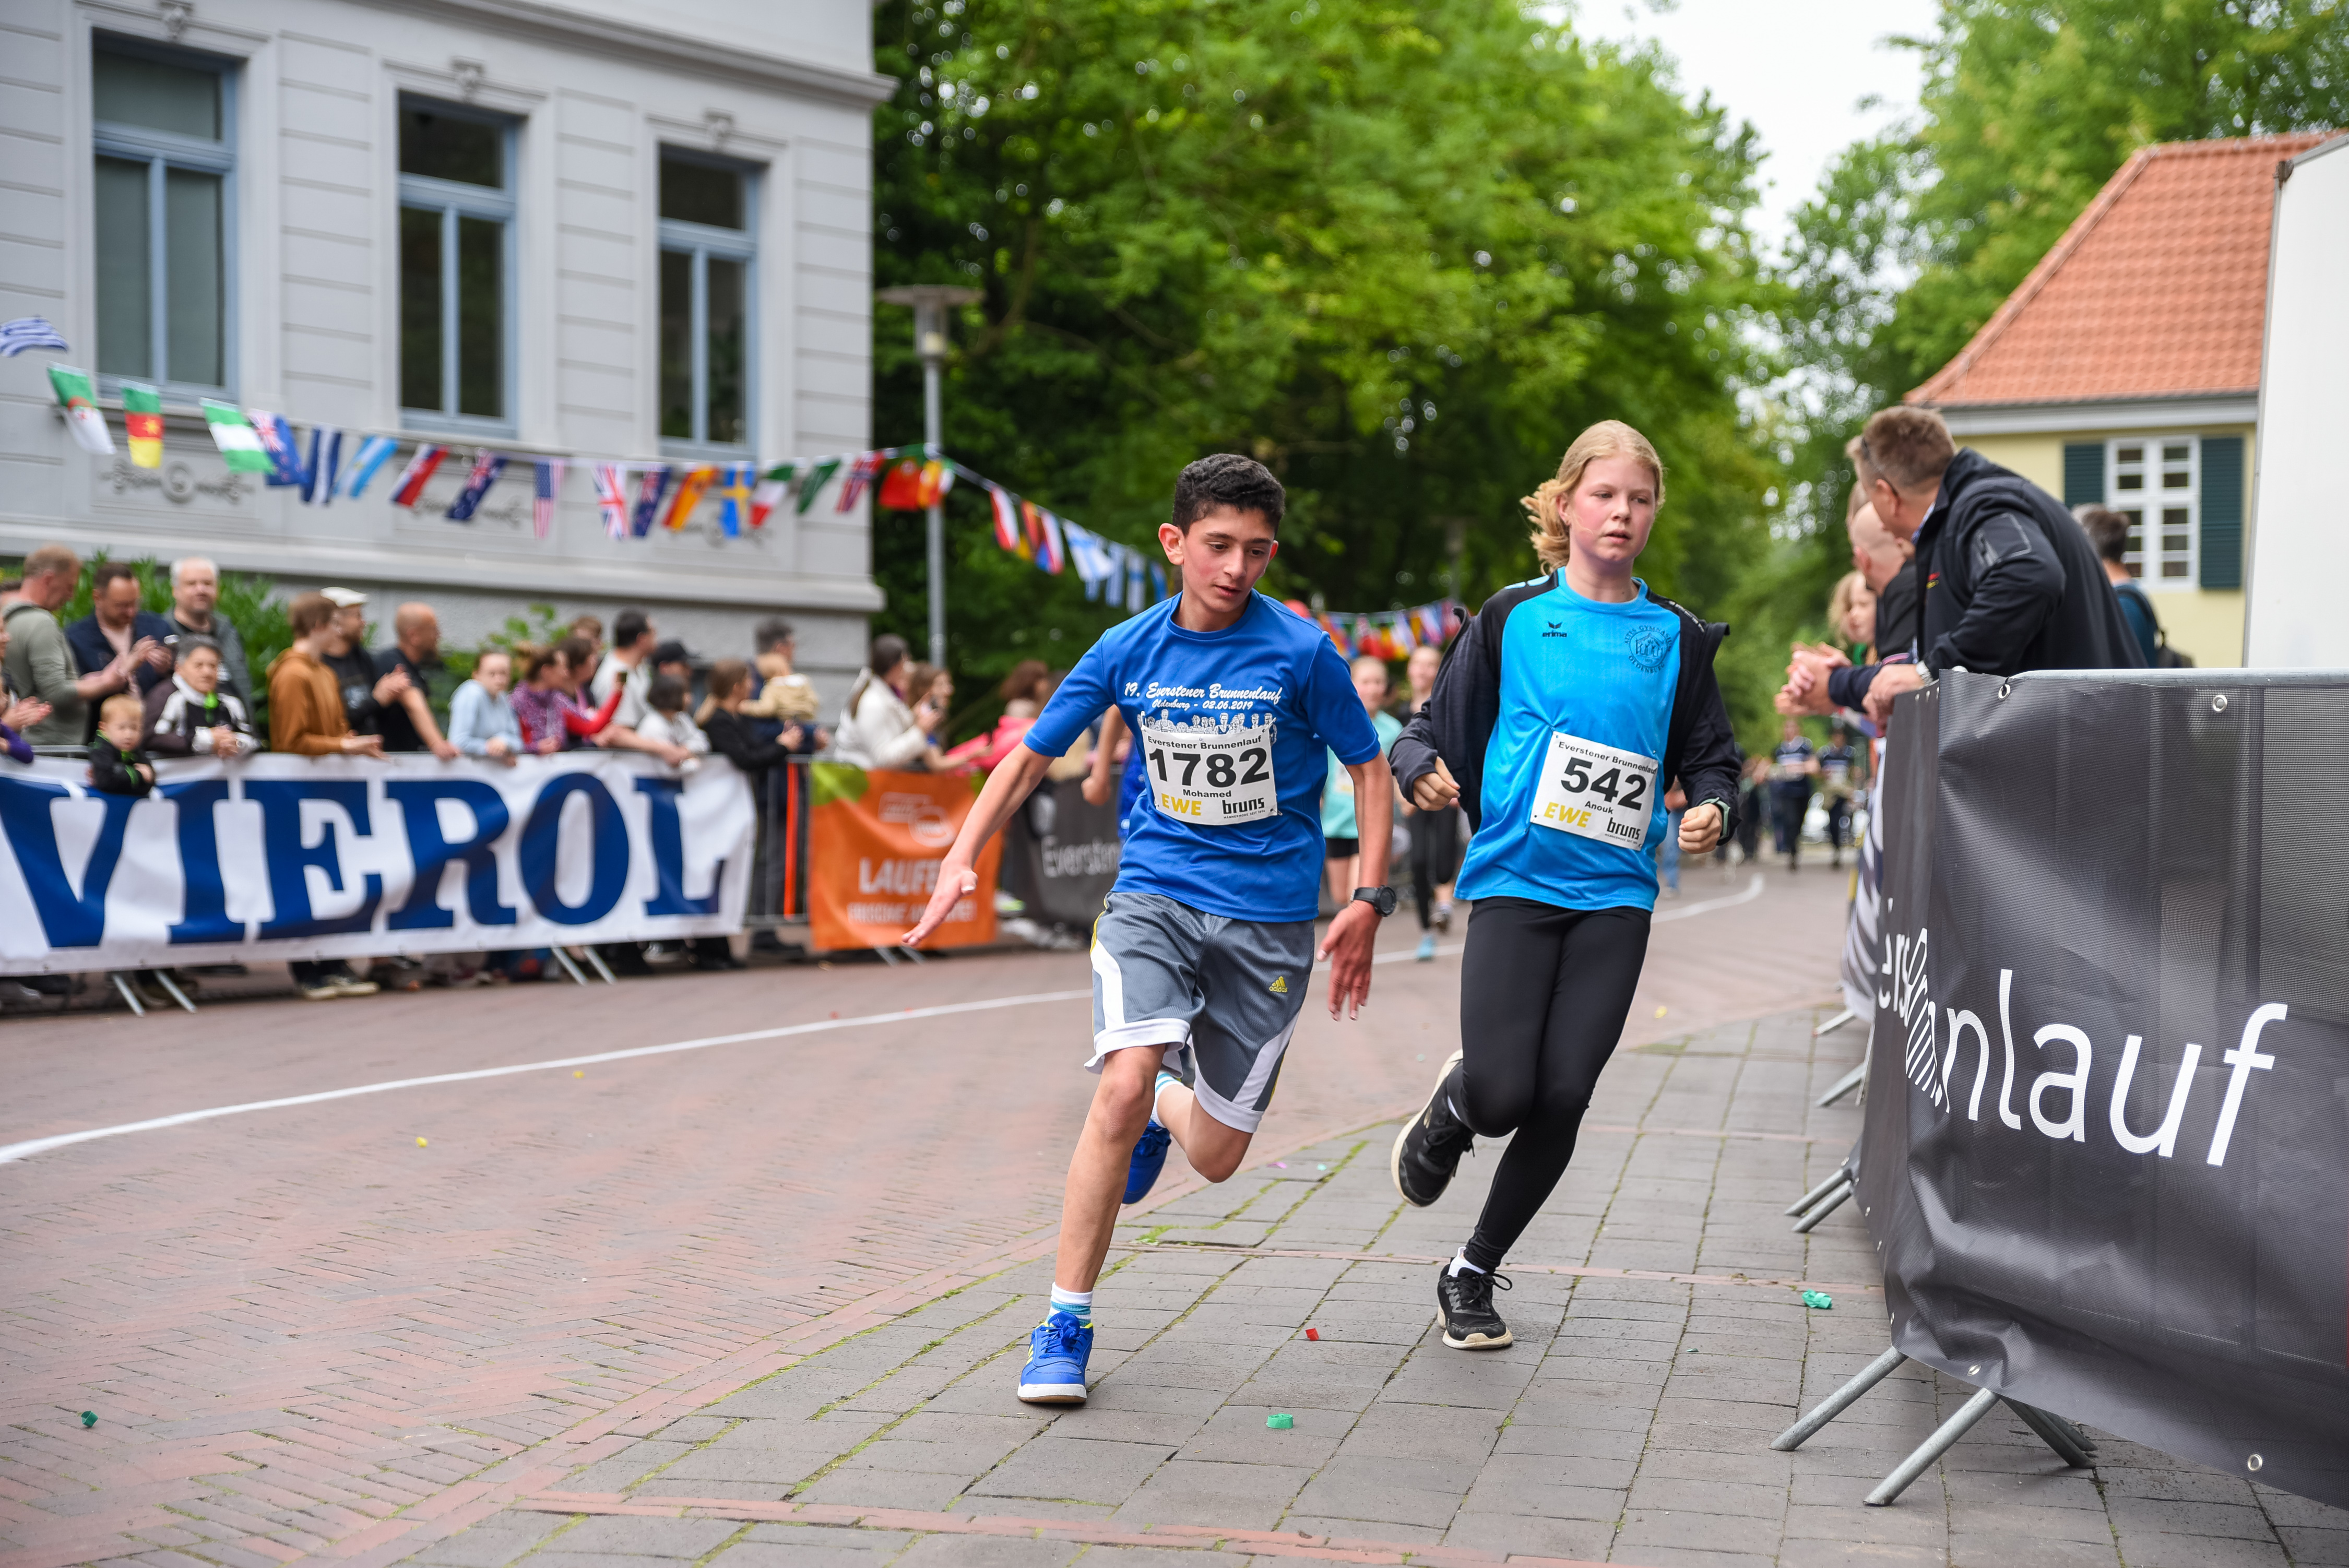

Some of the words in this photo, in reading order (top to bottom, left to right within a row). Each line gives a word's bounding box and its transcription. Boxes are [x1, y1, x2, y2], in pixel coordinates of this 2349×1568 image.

[1124, 682, 1140, 697] 19.
[1146, 682, 1205, 699] Everstener
[1209, 683, 1283, 705] Brunnenlauf
[1152, 698, 1191, 711] Oldenburg
[1202, 700, 1254, 710] 02.06.2019
[1147, 735, 1197, 749] Everstener
[1200, 735, 1262, 750] Brunnenlauf
[1558, 741, 1610, 761] Everstener
[1148, 747, 1270, 788] 1782
[1182, 789, 1232, 798] Mohamed
[1561, 756, 1647, 811] 542
[1161, 793, 1202, 816] EWE
[1221, 797, 1265, 815] bruns
[1543, 801, 1593, 828] EWE
[1584, 801, 1614, 815] Anouk
[1606, 816, 1641, 840] bruns
[0, 771, 725, 947] VIEROL
[859, 857, 942, 896] LAUFE
